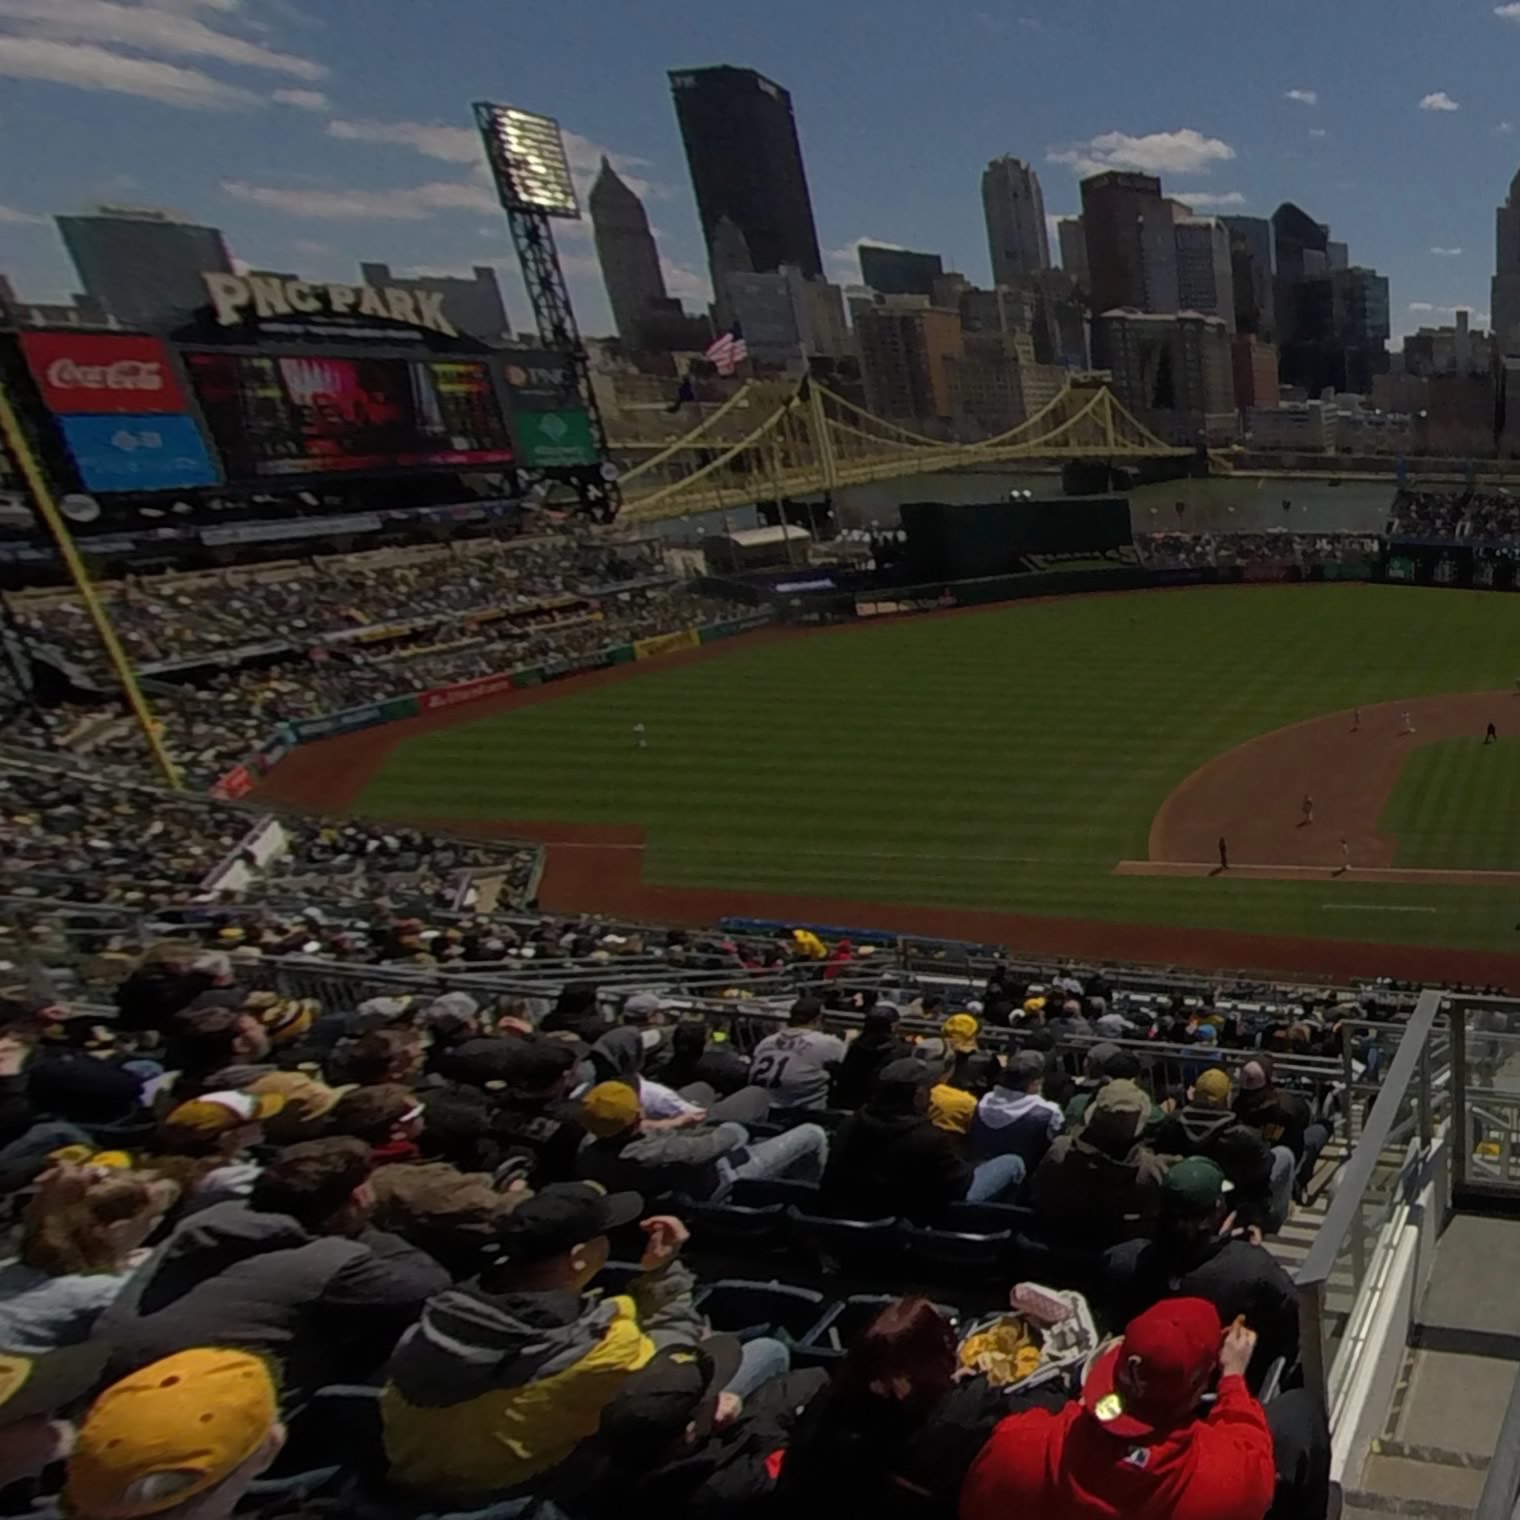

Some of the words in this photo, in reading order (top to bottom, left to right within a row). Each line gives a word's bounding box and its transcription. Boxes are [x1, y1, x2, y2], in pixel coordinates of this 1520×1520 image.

[202, 271, 323, 327] PNC
[327, 284, 460, 339] PARK
[752, 1056, 790, 1089] 21
